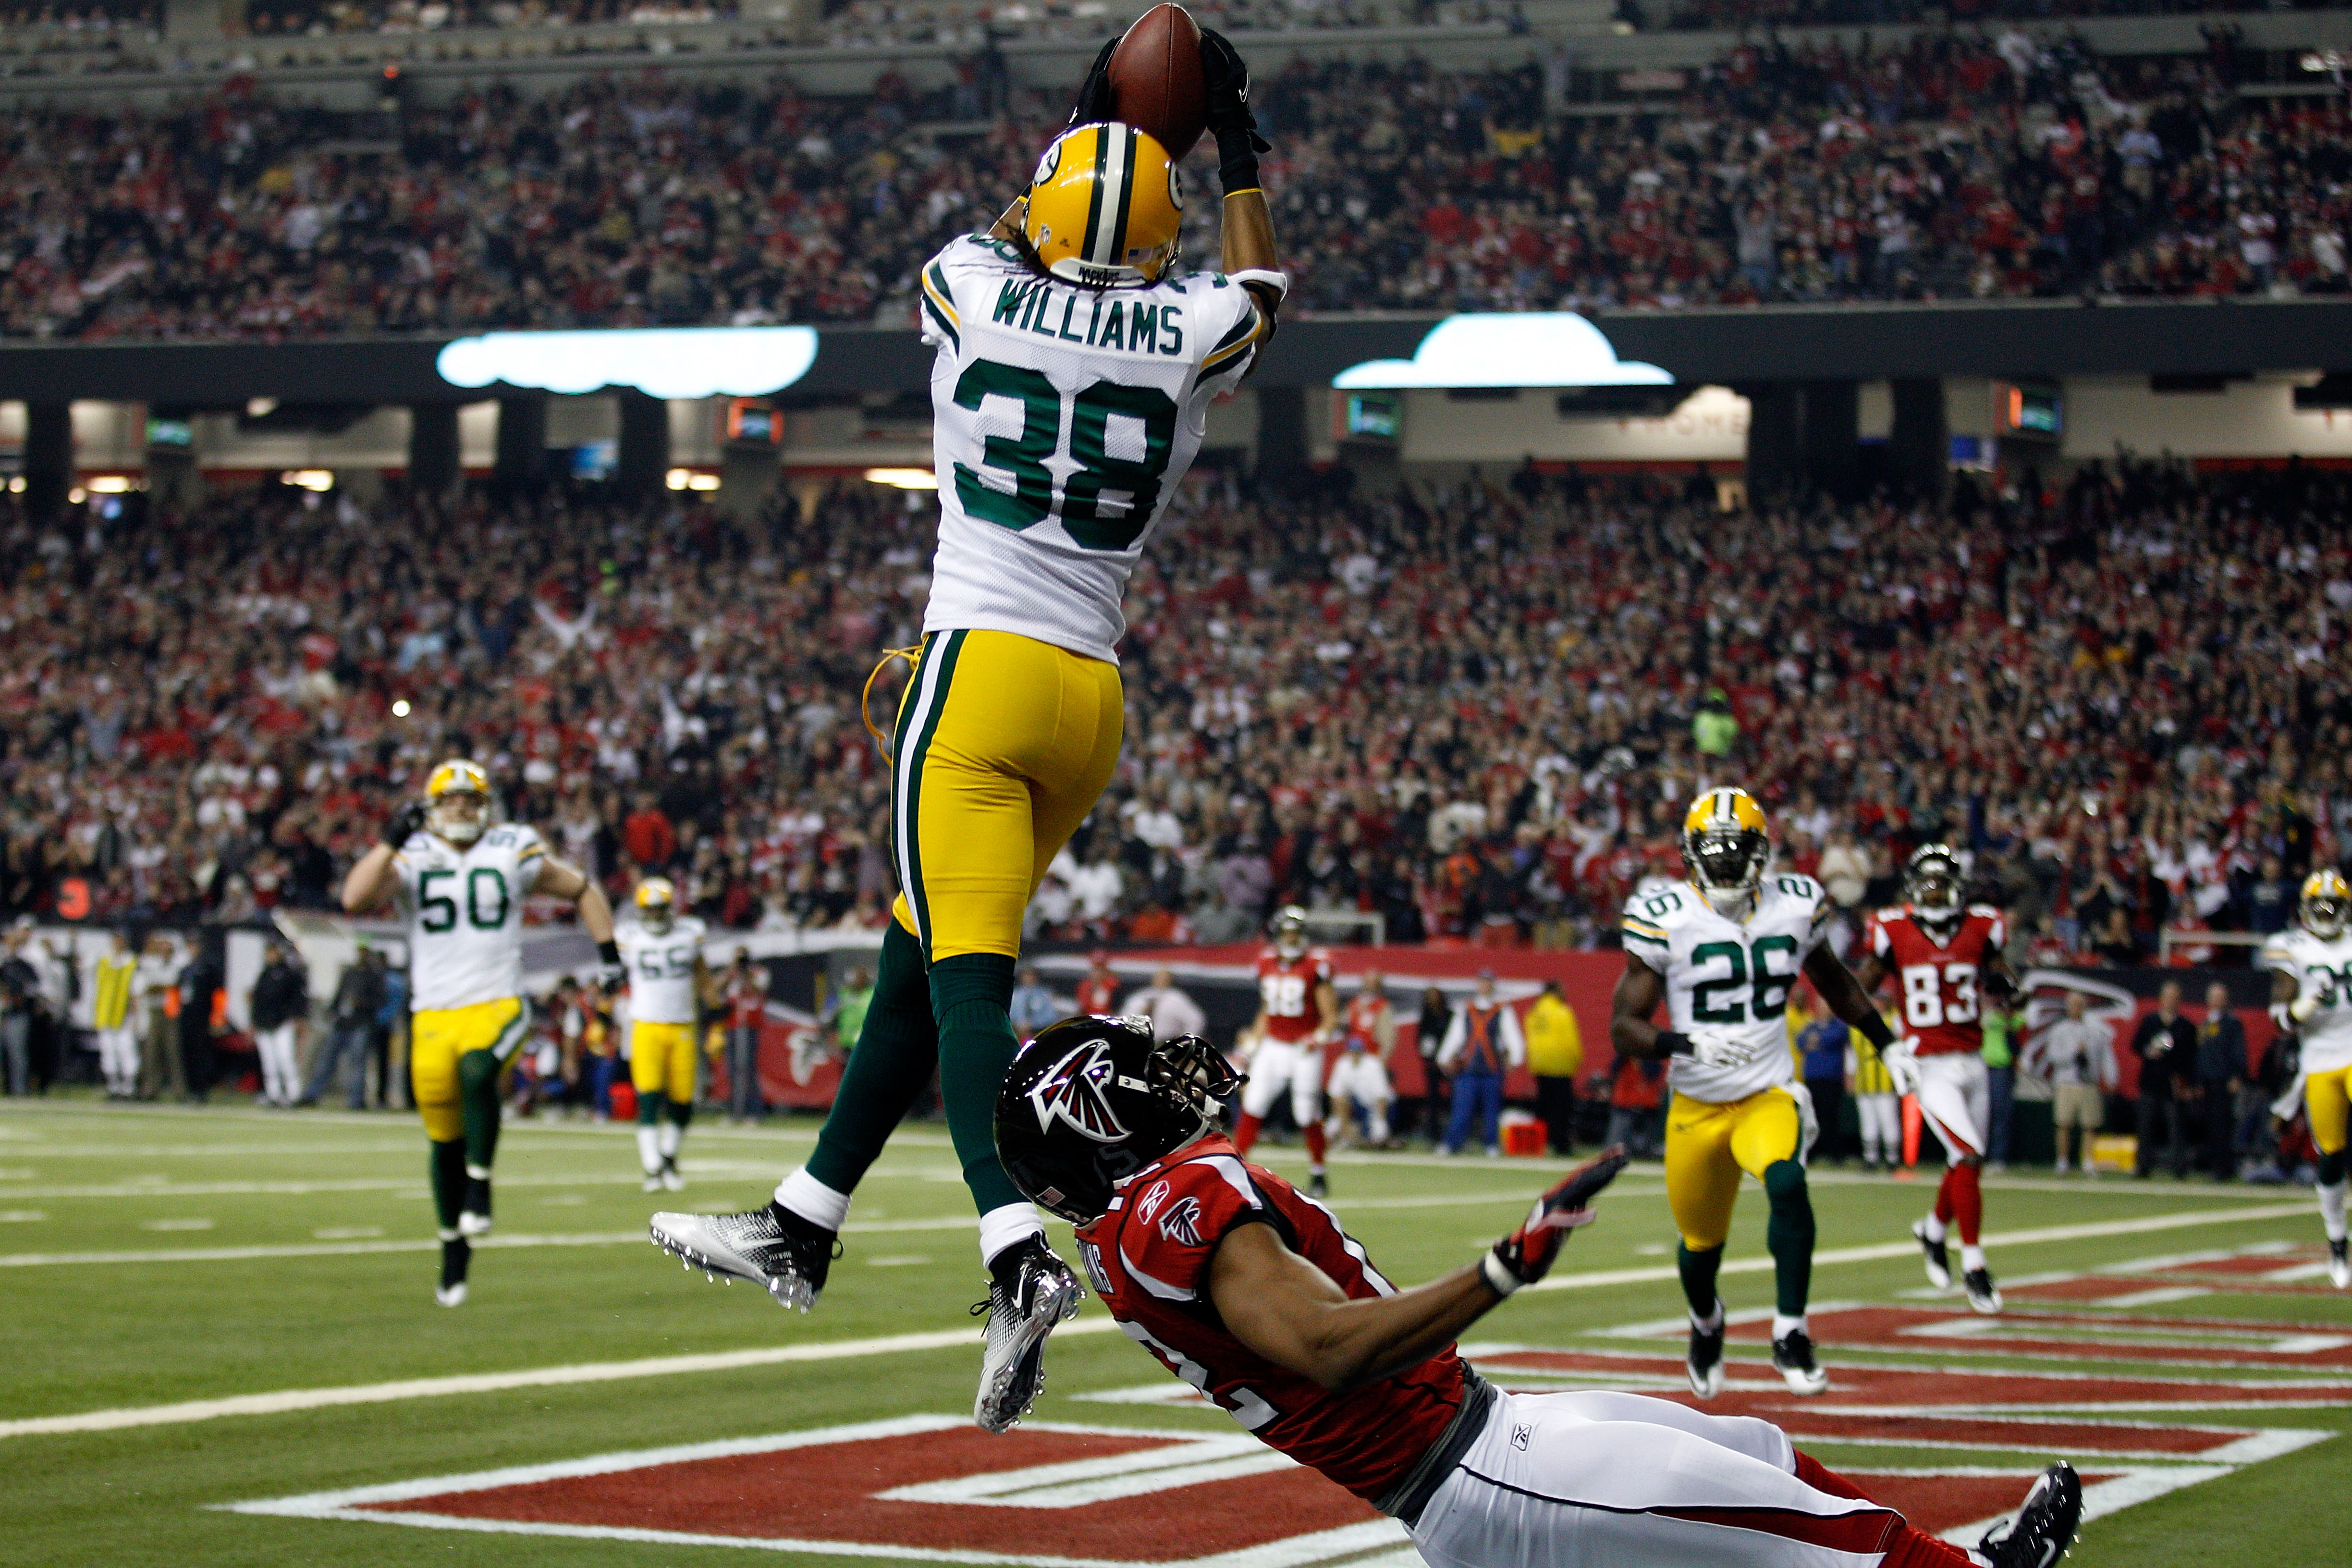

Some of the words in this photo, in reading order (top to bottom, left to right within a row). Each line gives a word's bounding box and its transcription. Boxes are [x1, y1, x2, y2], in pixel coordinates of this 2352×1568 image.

[992, 278, 1183, 355] WILLIAMS
[953, 357, 1178, 551] 38
[419, 867, 509, 933] 50
[1691, 934, 1797, 1023] 26
[1901, 962, 1978, 1028] 83
